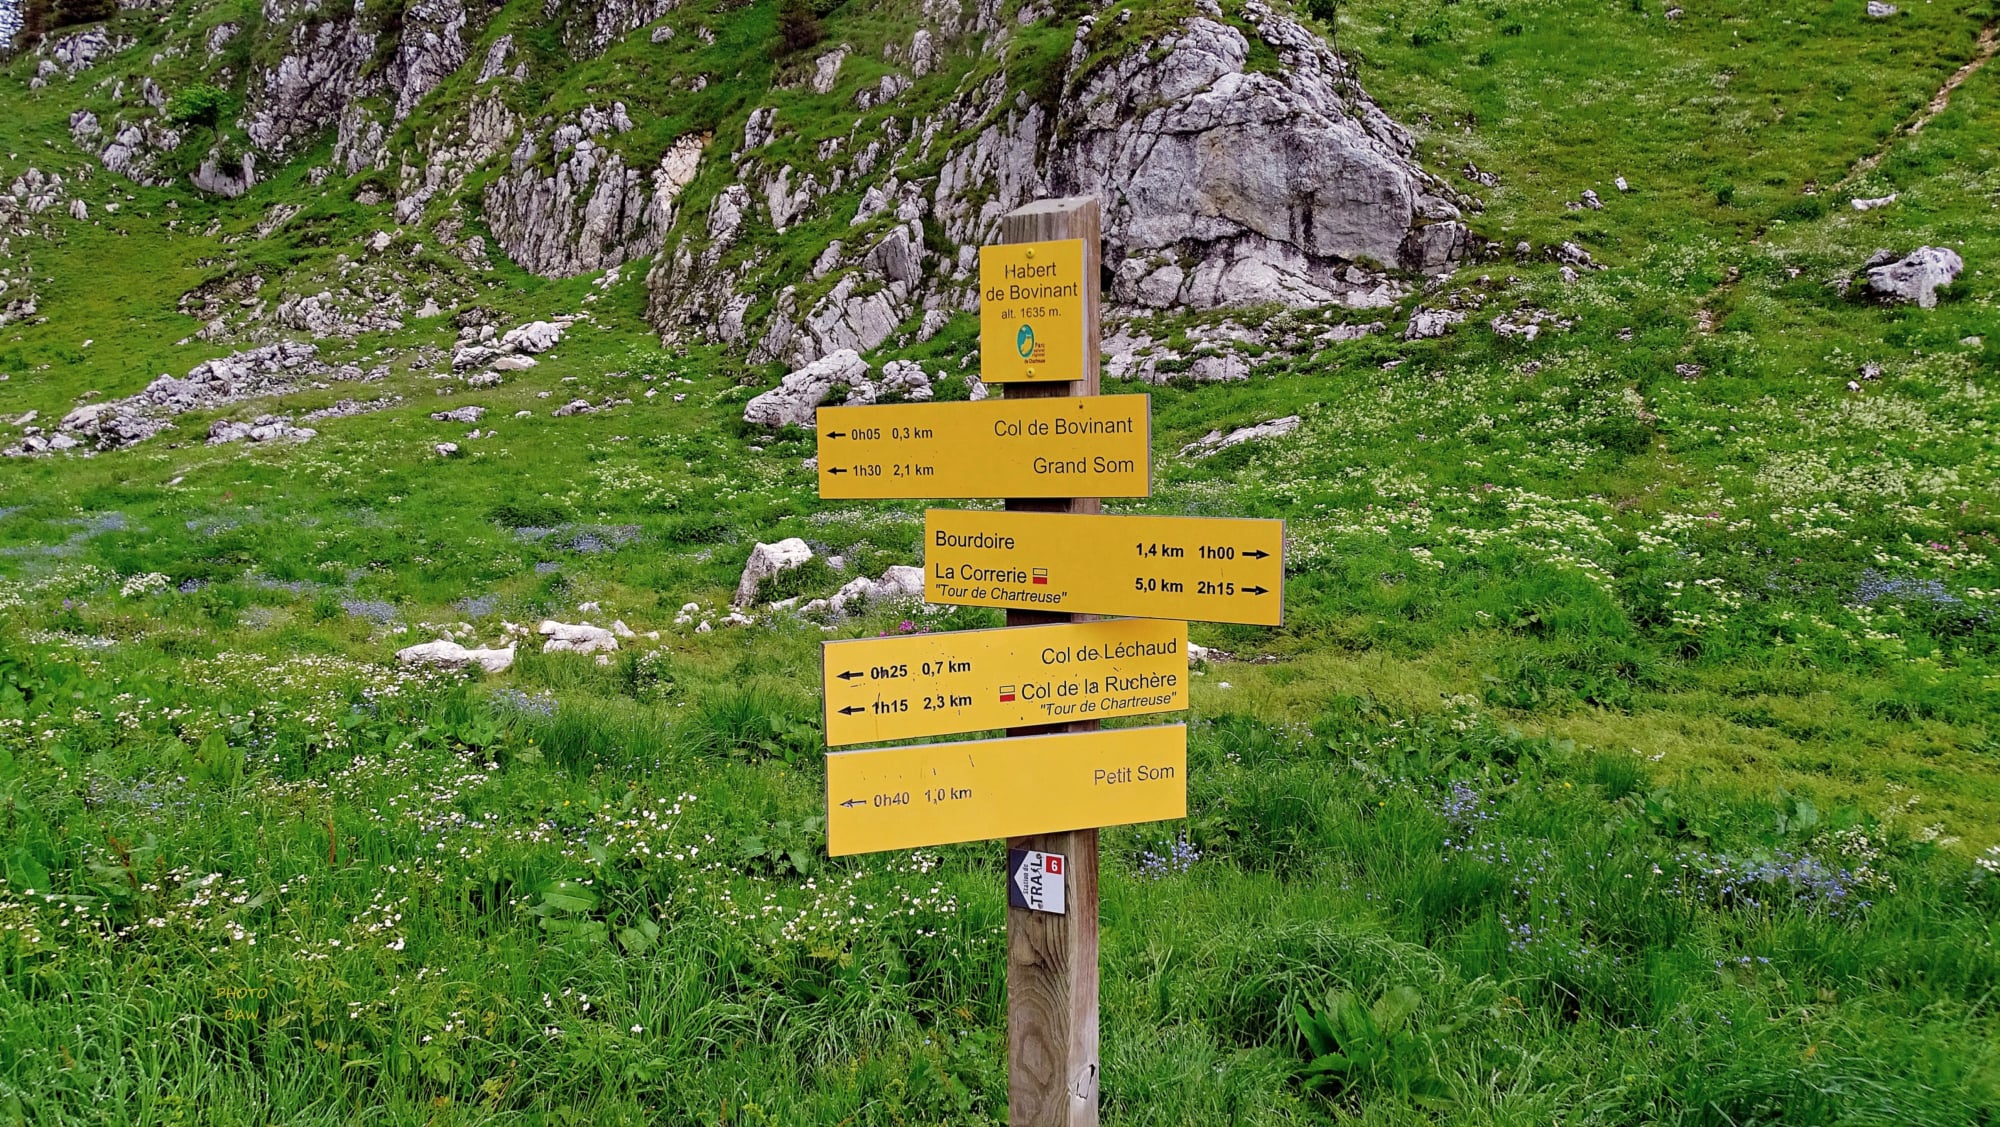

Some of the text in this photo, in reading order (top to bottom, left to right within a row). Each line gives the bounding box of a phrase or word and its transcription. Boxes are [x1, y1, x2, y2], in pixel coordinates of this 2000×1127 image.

[1005, 262, 1056, 279] Habert
[986, 282, 1078, 301] de Bovinant
[1002, 307, 1062, 319] alt. 1635 m.
[852, 427, 932, 441] 0h05 0,3 km
[994, 417, 1133, 436] Col de Bovinant
[853, 464, 934, 478] 1h30 2,1 km
[1034, 456, 1134, 474] Grand Som
[936, 530, 1014, 550] Bourdoire
[1136, 543, 1234, 560] 1,4 km 1h00
[936, 563, 1026, 584] La Correrie
[936, 584, 1068, 604] "Tour de Chartreuse"
[1136, 578, 1234, 596] 5,0 km 2h15
[1042, 638, 1177, 664] Col de Léchaud
[870, 660, 970, 680] 0h25 0,7 km
[1022, 672, 1176, 700] Col de la Ruchère
[872, 694, 972, 714] 1h15 2,3 km
[1040, 692, 1177, 716] "Tour de Chartreuse"
[1094, 765, 1174, 786] Petit Som
[874, 787, 972, 808] 0h40 1,0 km
[1052, 860, 1058, 872] 6
